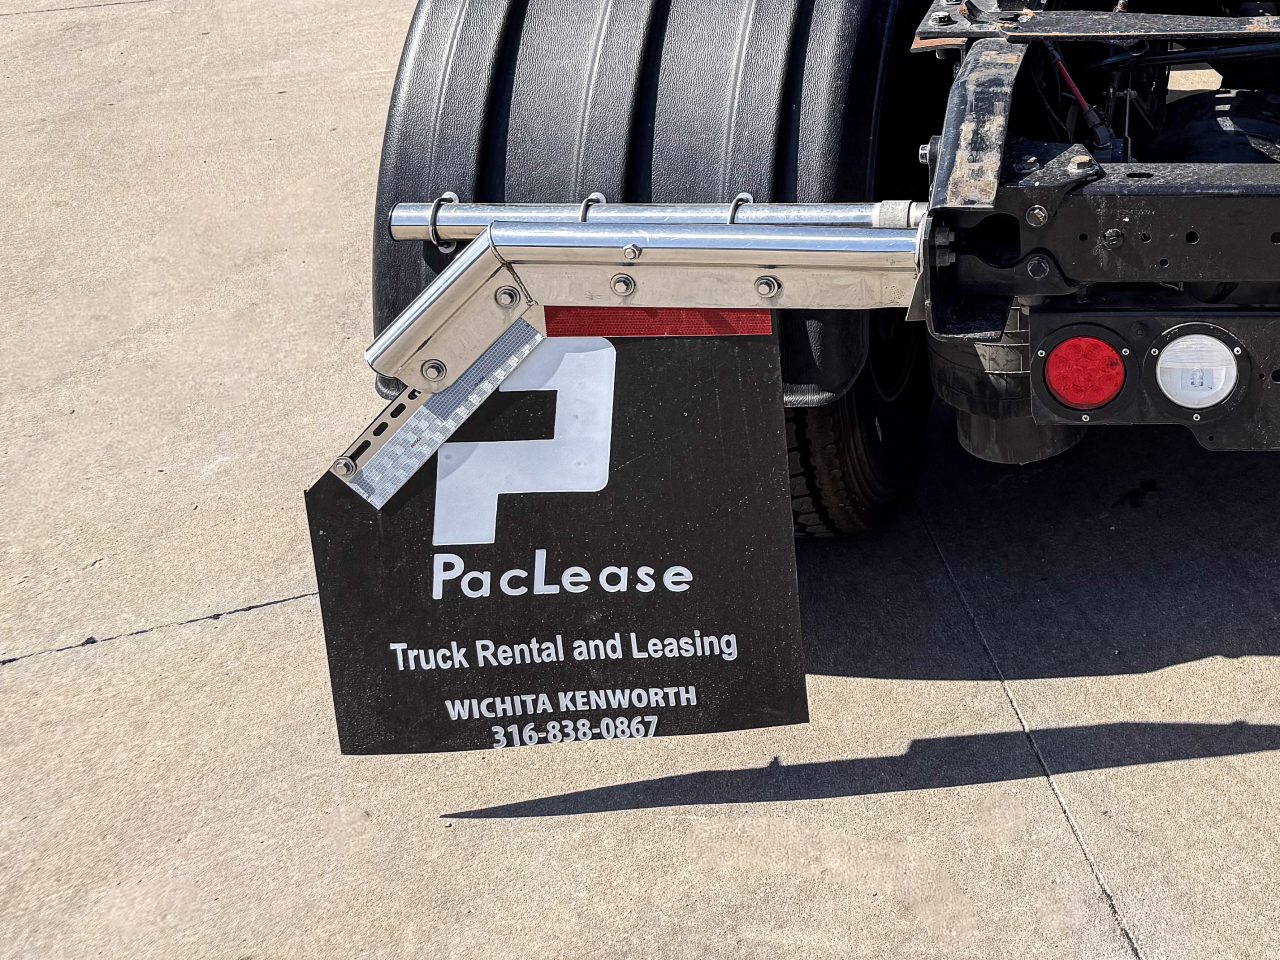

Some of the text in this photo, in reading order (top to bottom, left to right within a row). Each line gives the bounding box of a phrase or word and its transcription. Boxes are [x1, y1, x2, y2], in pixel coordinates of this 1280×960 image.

[432, 548, 693, 599] PacLease
[390, 630, 738, 671] Truck Rental and Leasing
[445, 686, 696, 720] WICHITA KENWORTH
[491, 715, 659, 748] 316-838-0867
